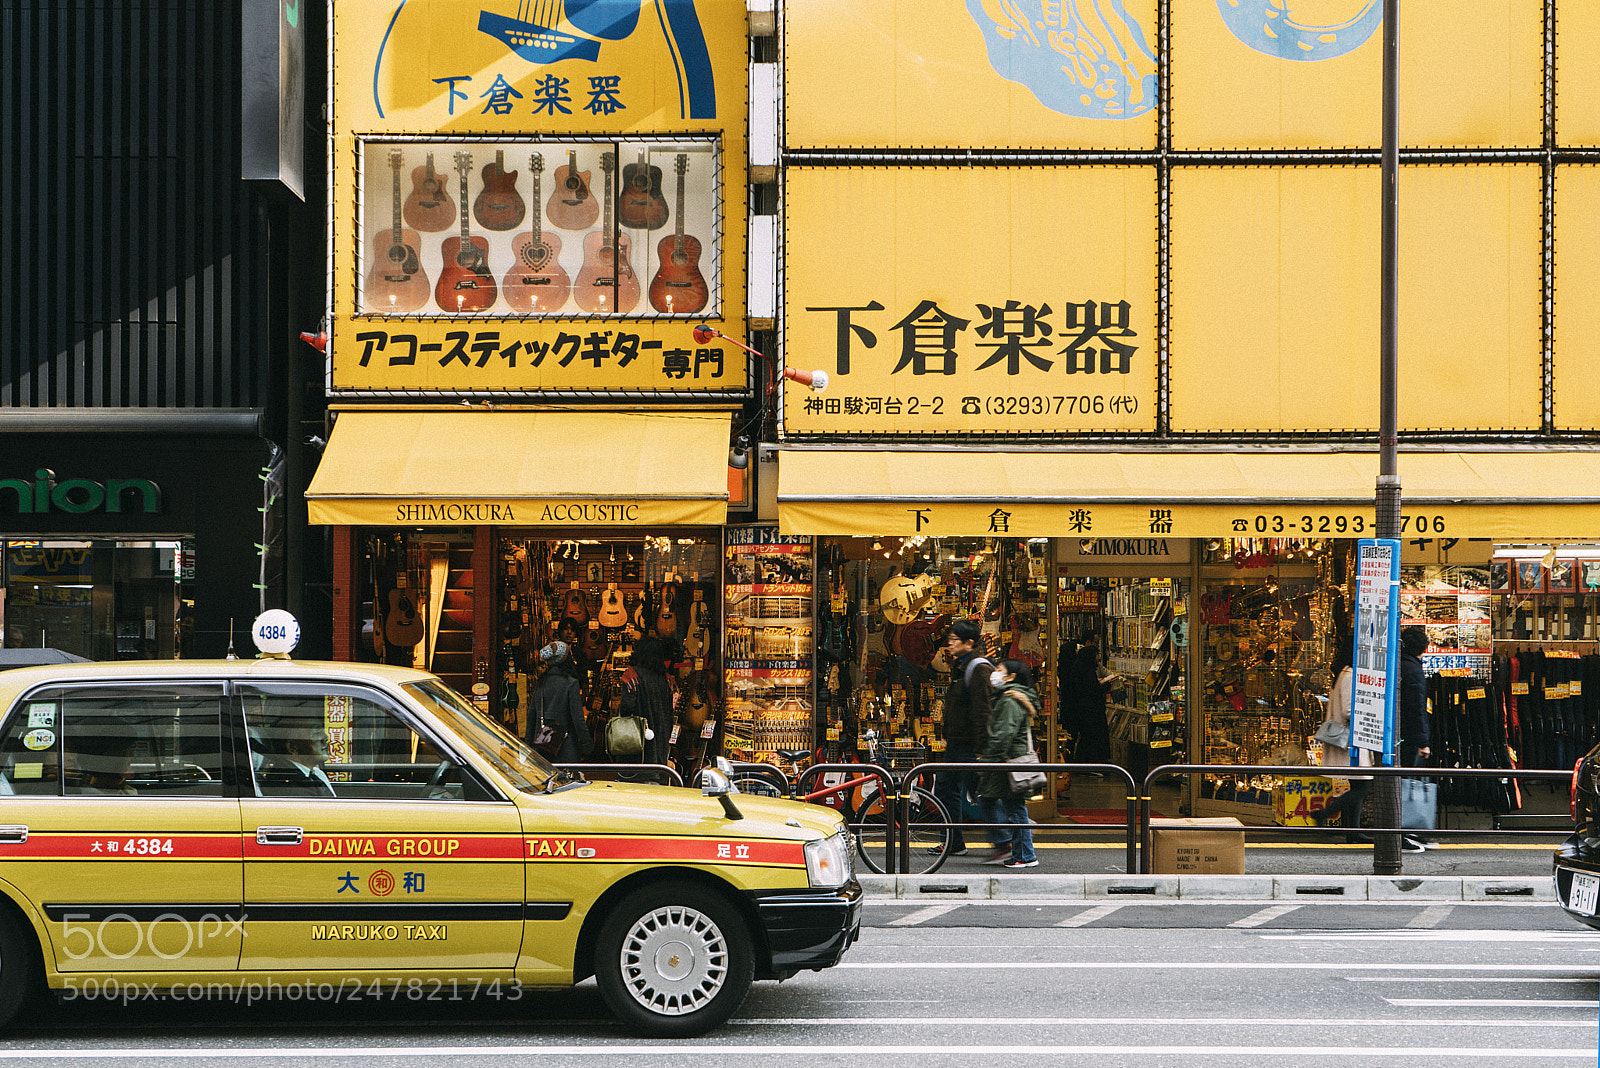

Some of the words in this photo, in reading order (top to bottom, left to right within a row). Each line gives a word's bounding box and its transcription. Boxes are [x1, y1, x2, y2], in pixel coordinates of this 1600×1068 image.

[432, 74, 626, 116] 下倉楽器
[805, 299, 1140, 376] 下倉楽器
[396, 503, 515, 522] SHIMOKURA
[540, 503, 640, 522] ACOUSTIC
[259, 625, 287, 640] 4384
[91, 840, 119, 854] 大和
[123, 839, 174, 856] 4384
[308, 838, 378, 857] DAIWA
[385, 838, 461, 857] GROUP
[526, 838, 577, 858] TAXI
[716, 843, 750, 859] 足立
[310, 925, 398, 942] MARUKO
[402, 925, 448, 942] TAXI
